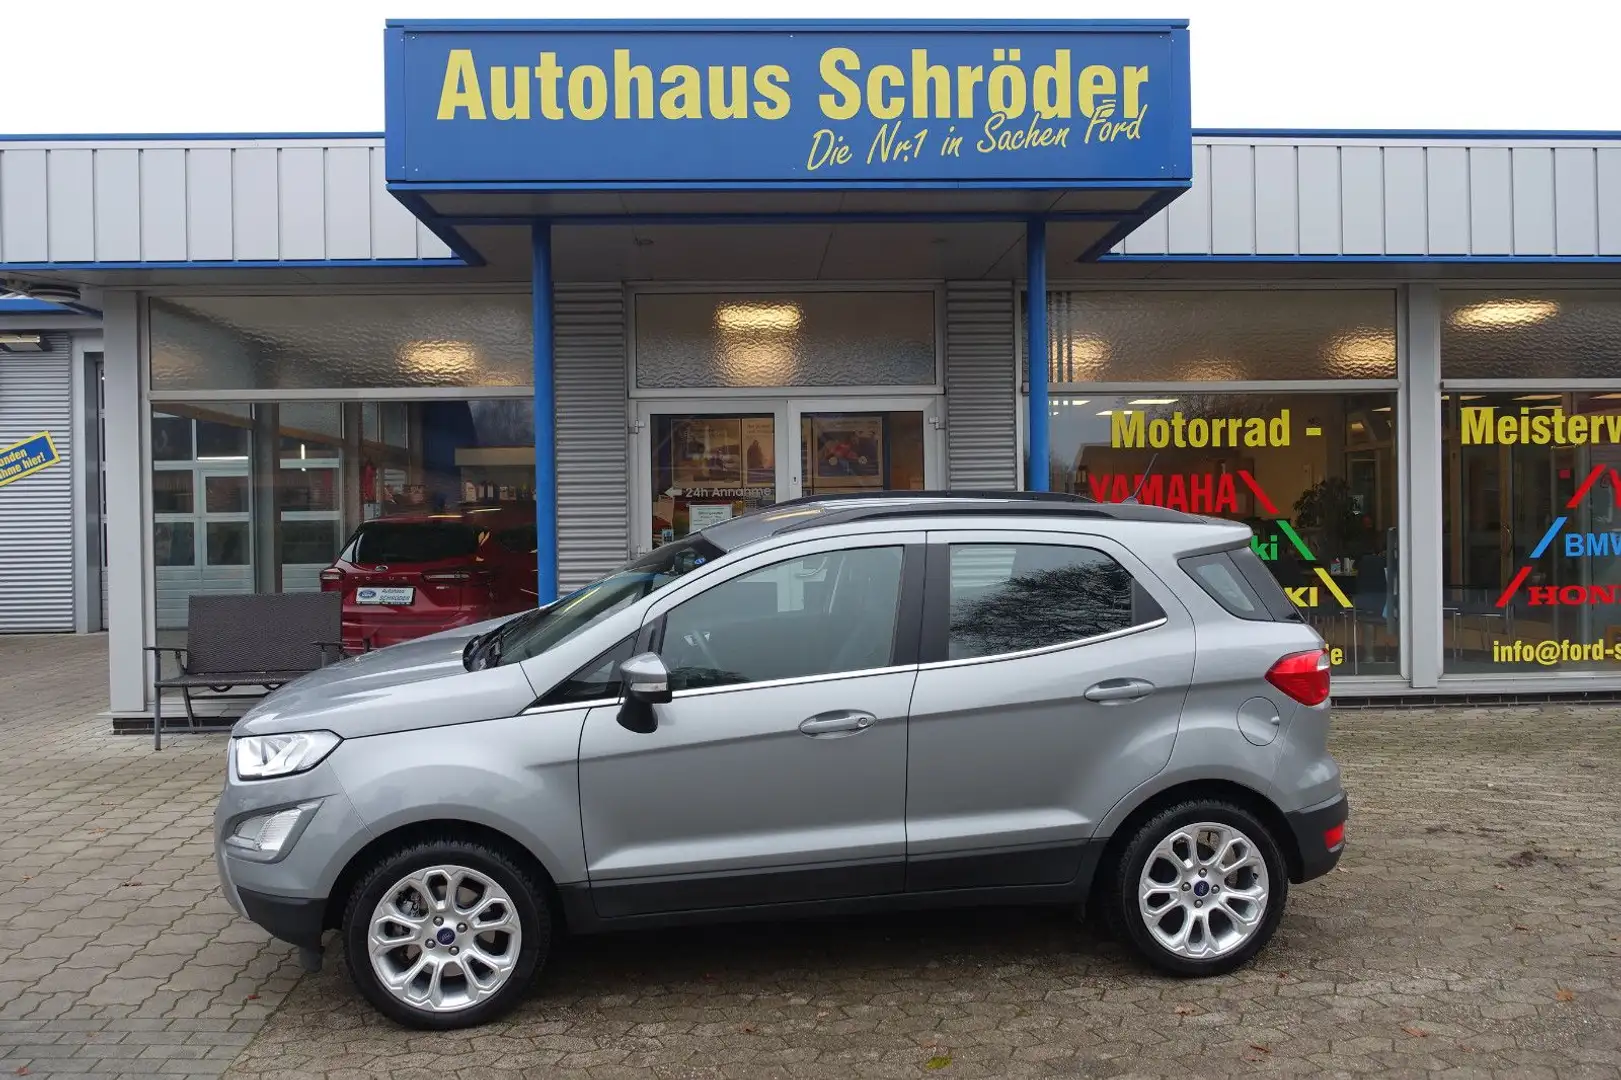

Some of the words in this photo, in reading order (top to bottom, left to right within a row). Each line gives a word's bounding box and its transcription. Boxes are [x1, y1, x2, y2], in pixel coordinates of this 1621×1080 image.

[437, 49, 790, 120] Autohaus
[819, 48, 1148, 119] Schröder
[806, 129, 853, 171] Die
[866, 120, 929, 163] Nr.1
[940, 126, 963, 157] in
[976, 112, 1071, 153] Sachen
[1084, 98, 1149, 144] Ford
[1109, 409, 1290, 449] Motorrad
[685, 488, 709, 498] 24h
[711, 487, 772, 498] Annahme
[1088, 472, 1238, 513] YAMAHA
